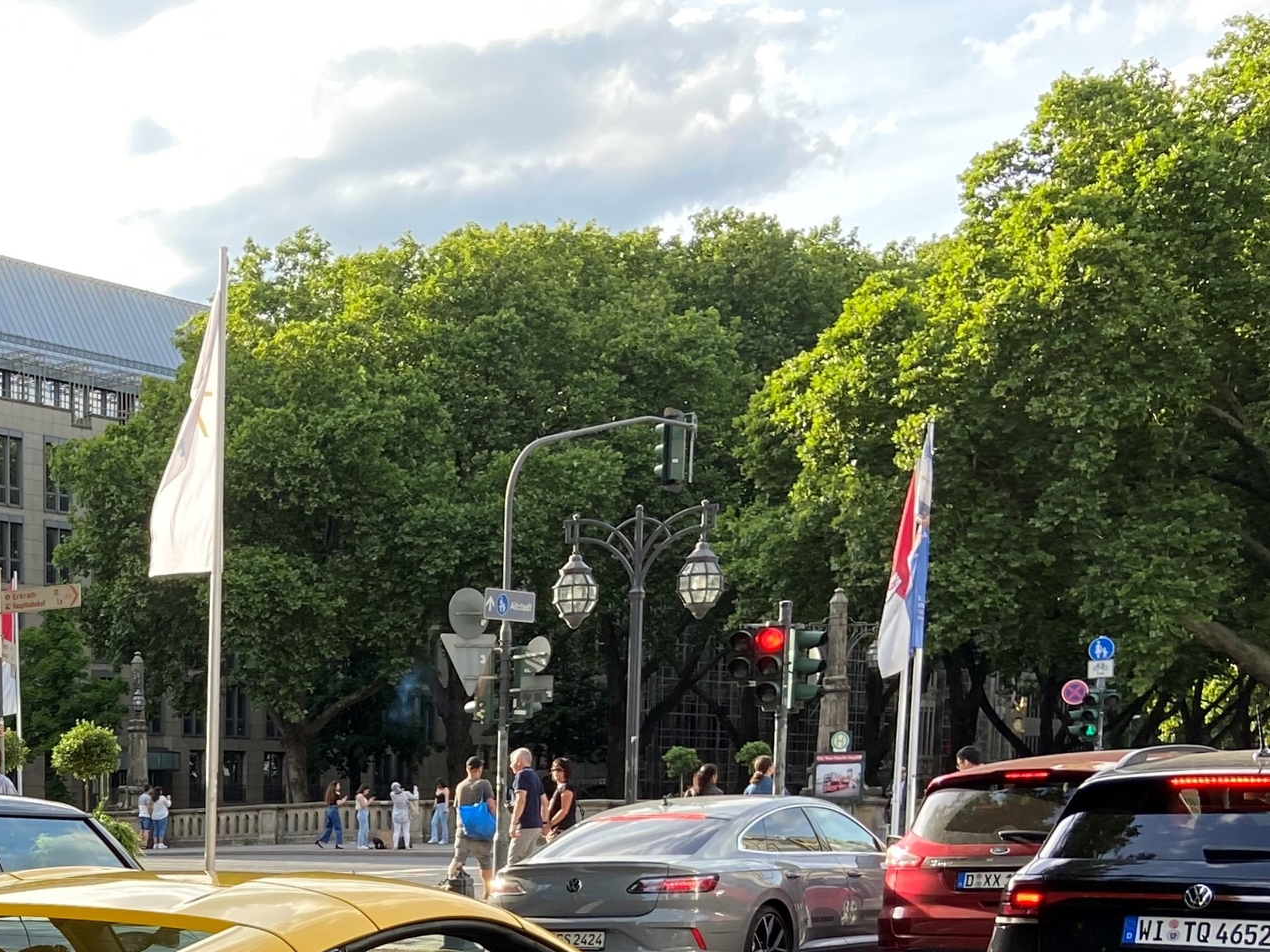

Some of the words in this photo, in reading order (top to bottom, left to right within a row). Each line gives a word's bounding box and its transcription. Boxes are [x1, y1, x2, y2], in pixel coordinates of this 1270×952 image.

[12, 592, 36, 600] Erkrath
[965, 874, 975, 887] D
[983, 874, 1002, 887] XX
[573, 933, 603, 946] 2424
[1139, 920, 1164, 941] WI
[1184, 921, 1211, 943] TQ
[1215, 923, 1270, 946] 4652
